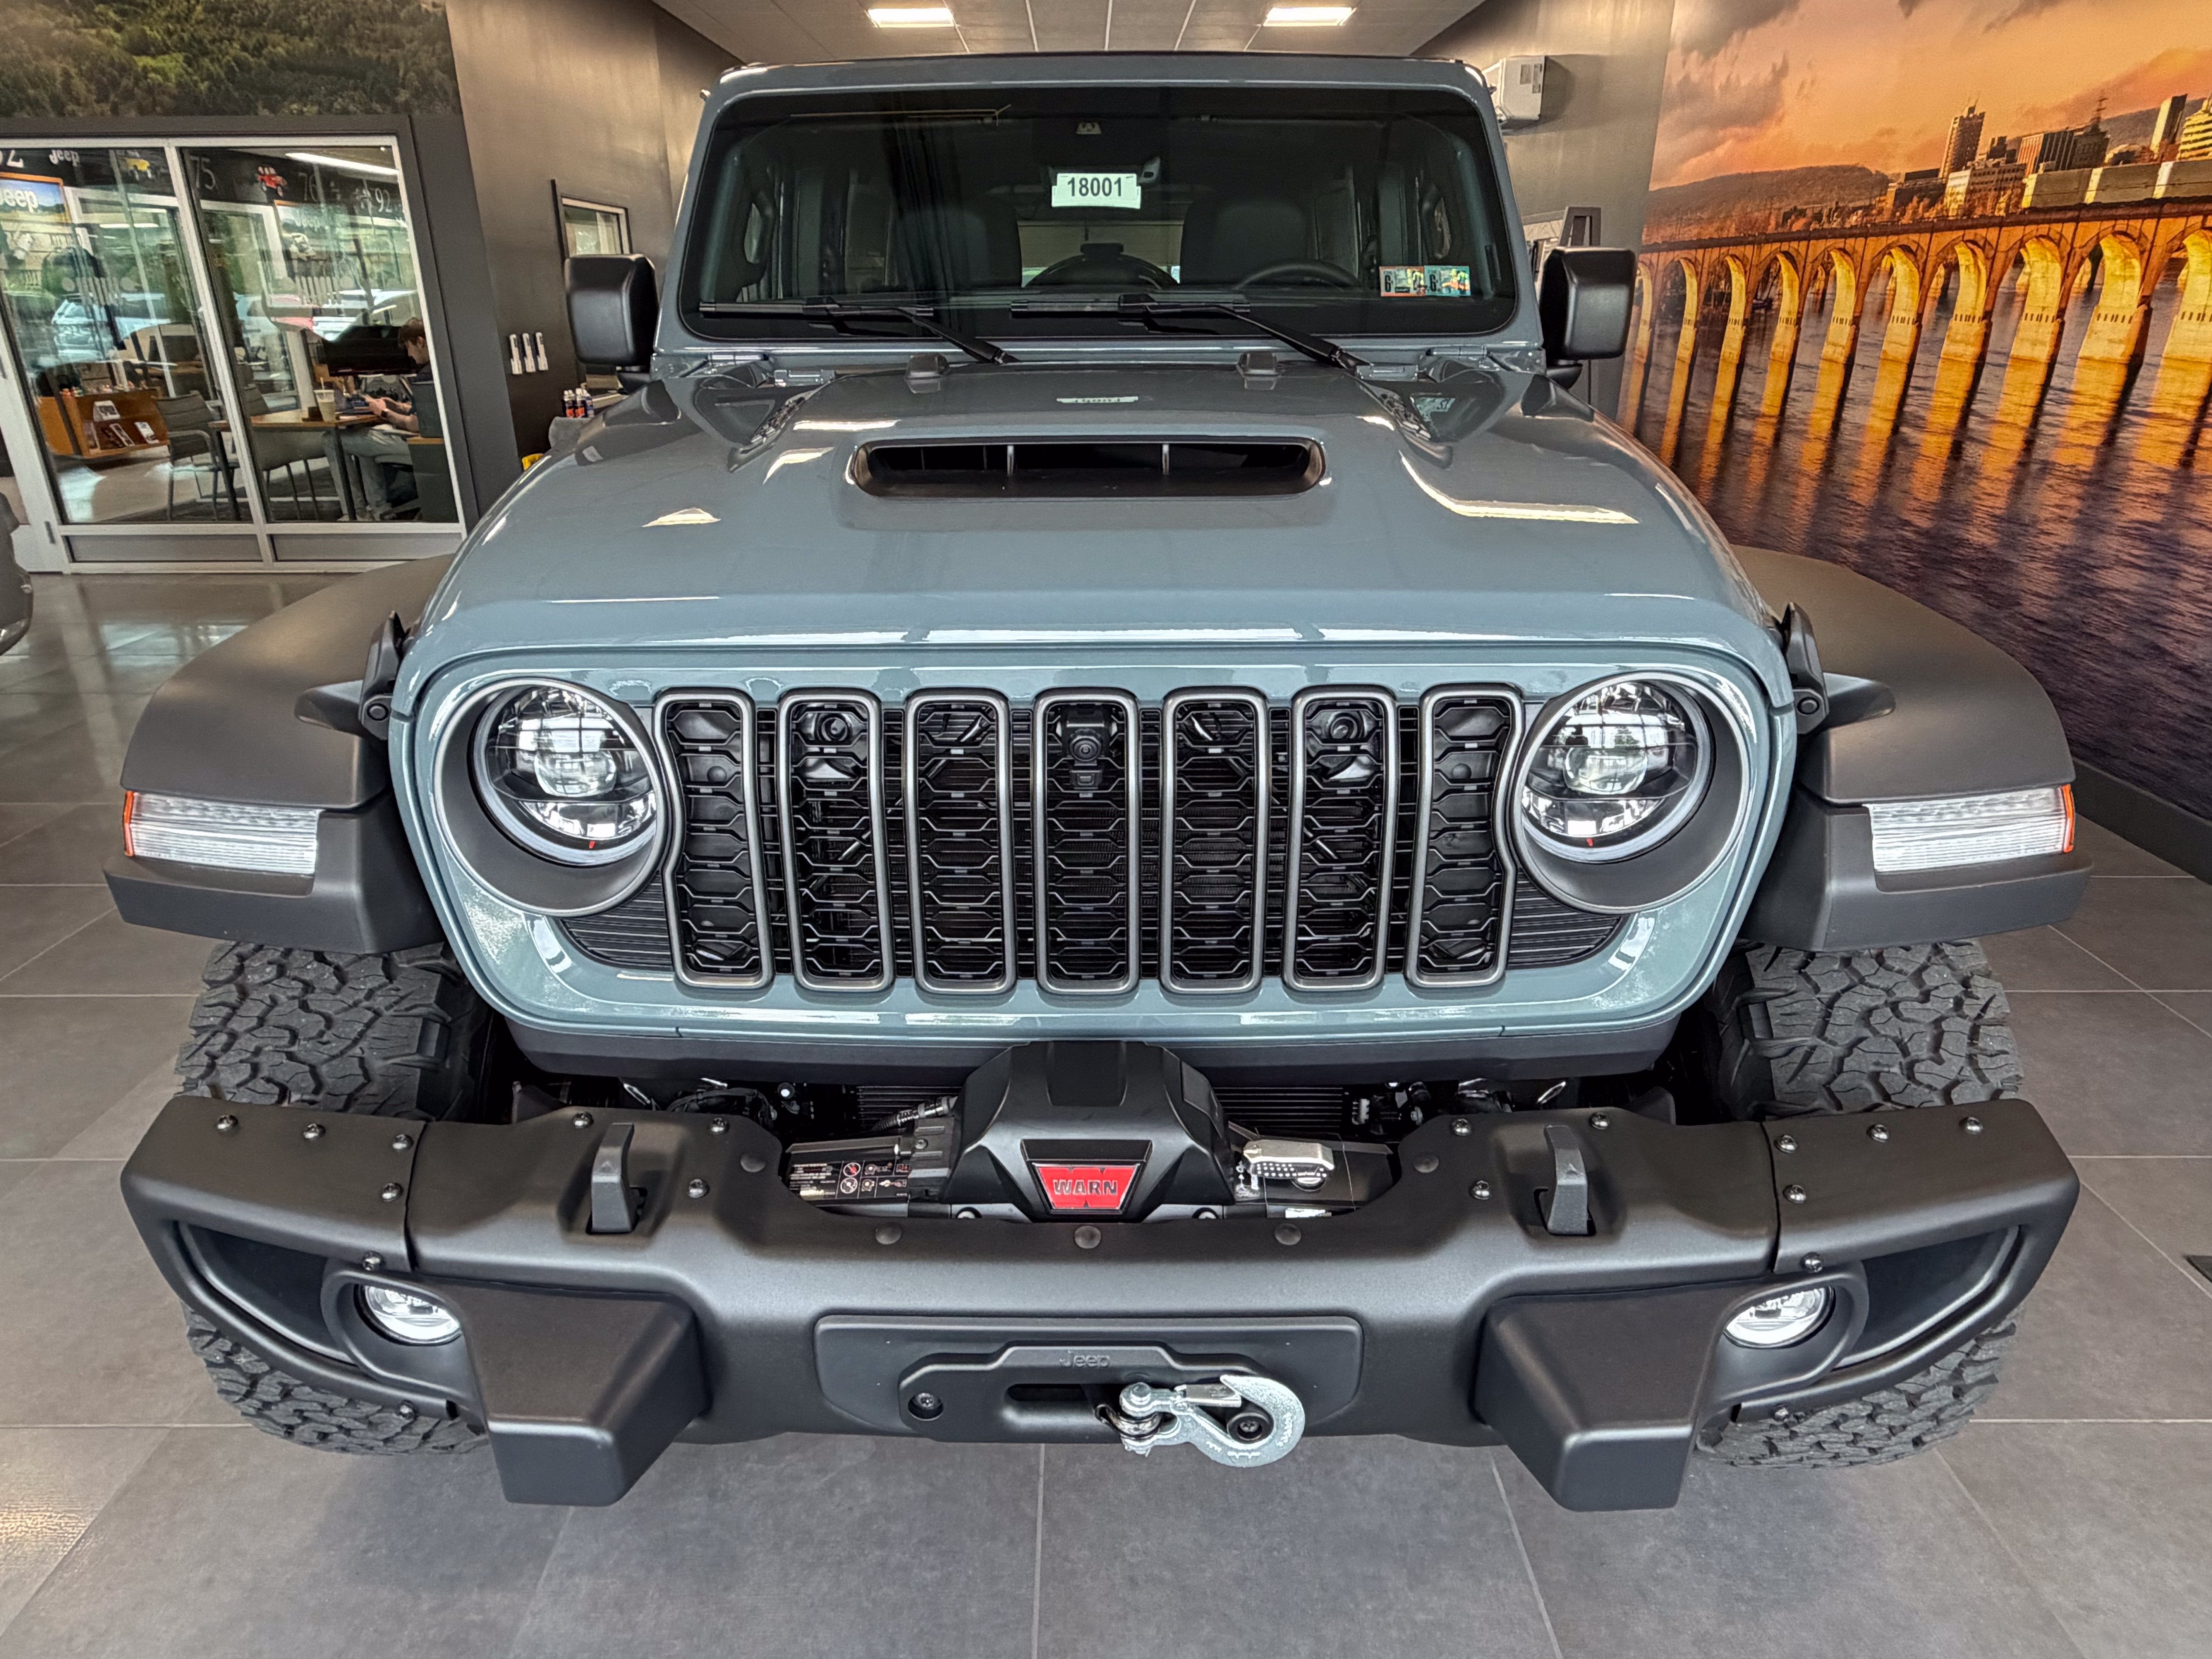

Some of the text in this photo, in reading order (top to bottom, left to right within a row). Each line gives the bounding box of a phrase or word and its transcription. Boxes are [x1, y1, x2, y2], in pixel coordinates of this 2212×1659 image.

[49, 149, 80, 167] Jeep
[1067, 177, 1121, 197] 18001
[1053, 1179, 1118, 1195] WARN
[1059, 1350, 1110, 1367] Jeep
